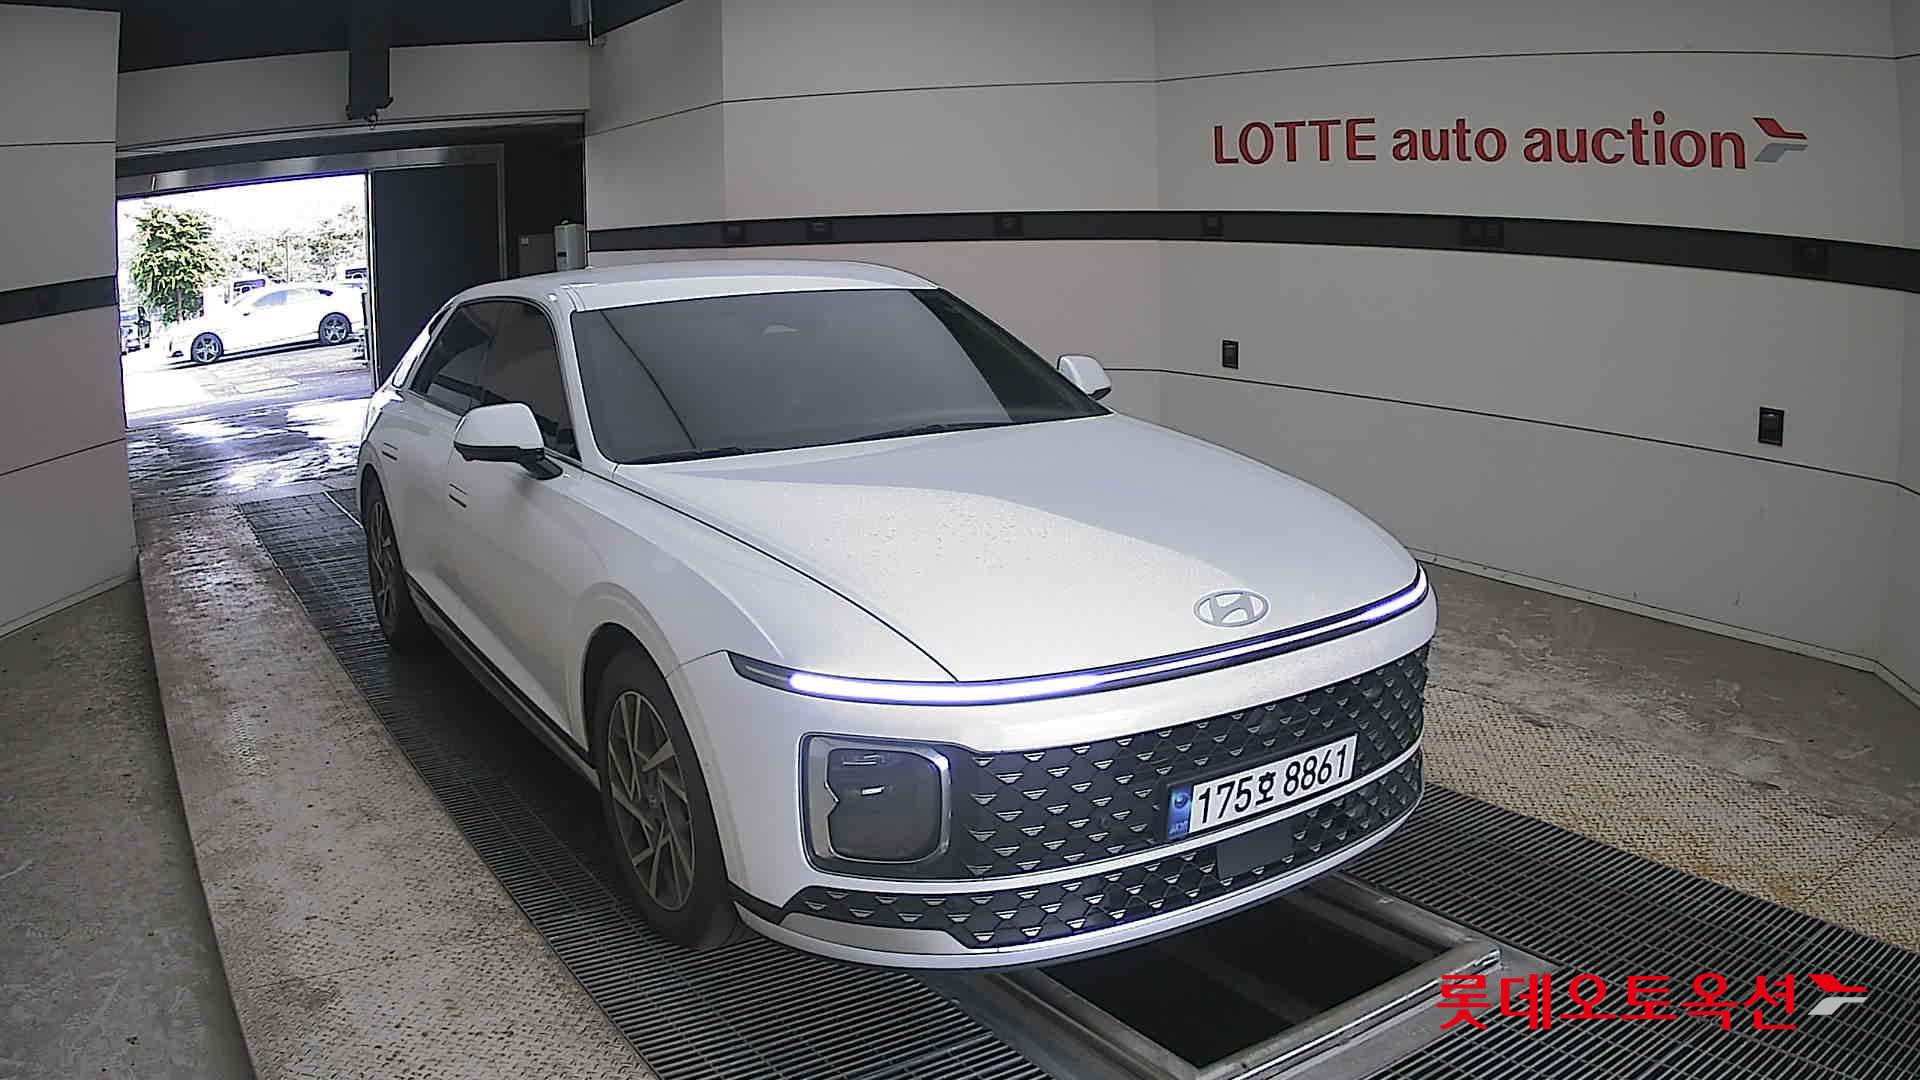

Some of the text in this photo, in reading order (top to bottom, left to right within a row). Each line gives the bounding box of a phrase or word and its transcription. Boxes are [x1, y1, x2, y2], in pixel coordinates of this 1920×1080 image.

[1214, 111, 1746, 169] LOTTE auto auction
[1198, 744, 1347, 824] 175호 8861
